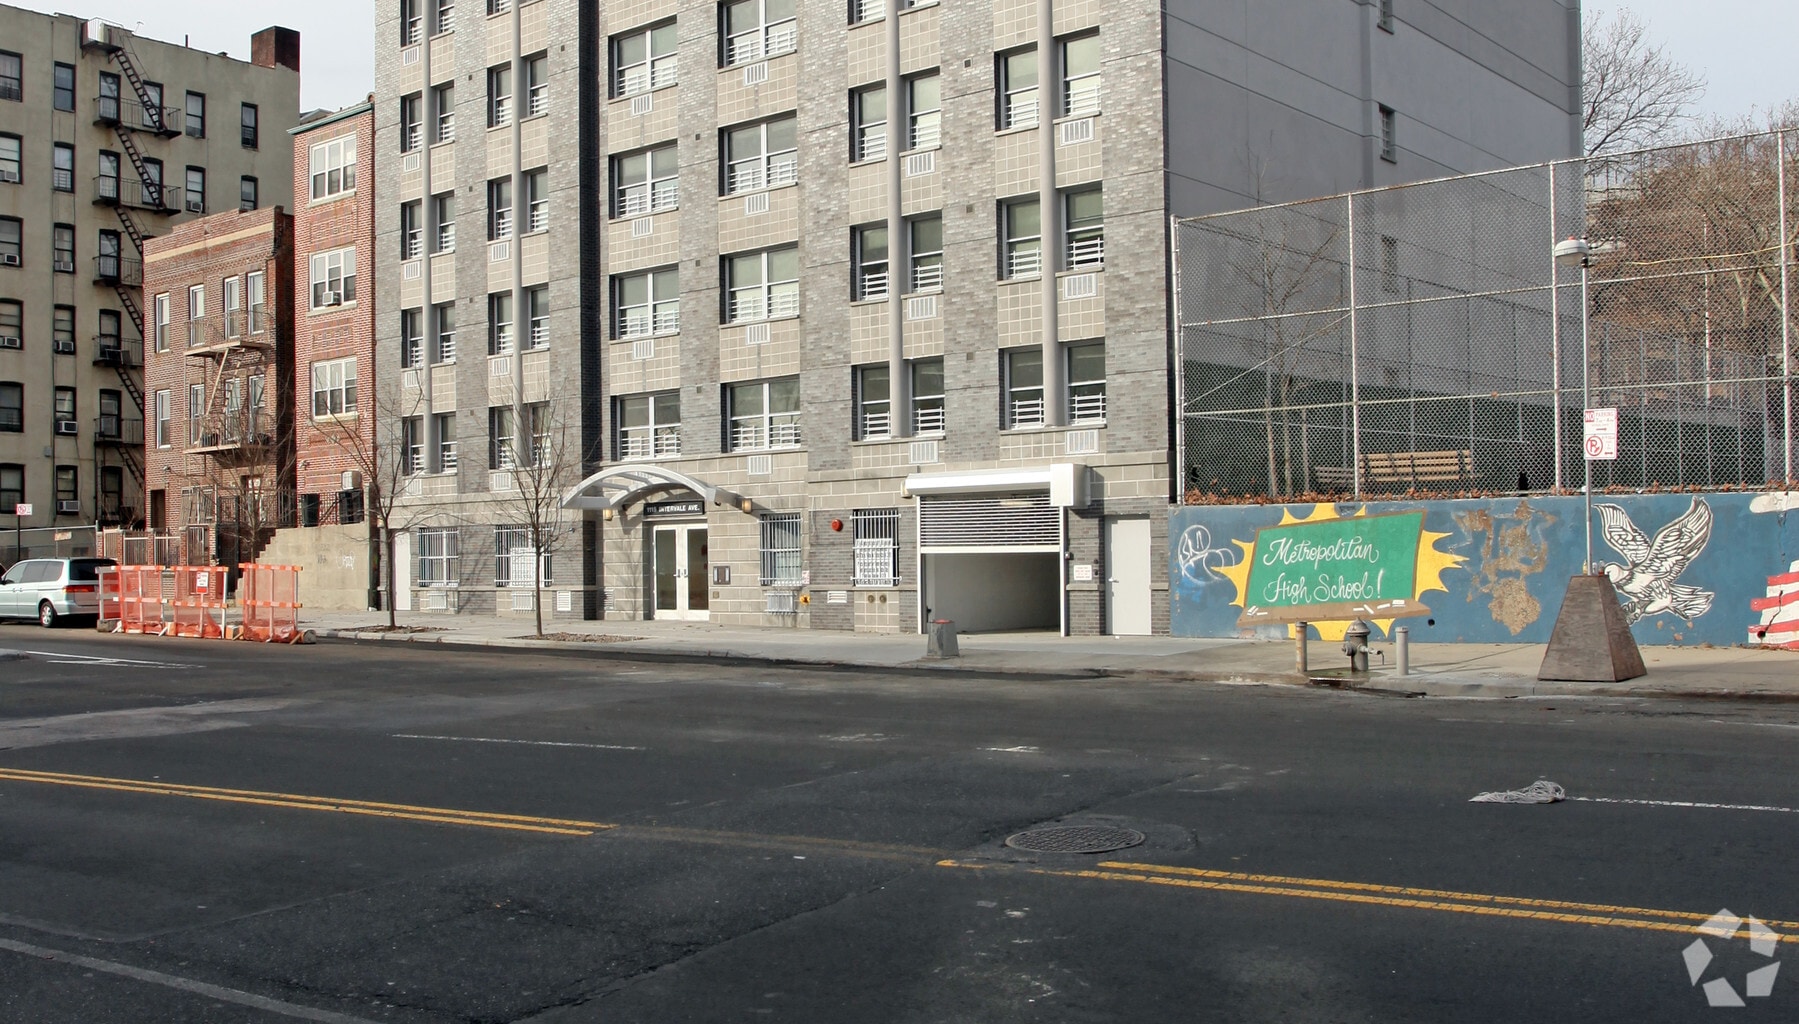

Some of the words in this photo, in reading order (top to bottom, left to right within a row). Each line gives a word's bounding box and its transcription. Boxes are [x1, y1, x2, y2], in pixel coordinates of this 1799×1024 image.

[1585, 411, 1594, 422] NO
[659, 504, 687, 513] INTERVALE
[1263, 536, 1380, 570] Metropolitan
[1263, 572, 1312, 605] High
